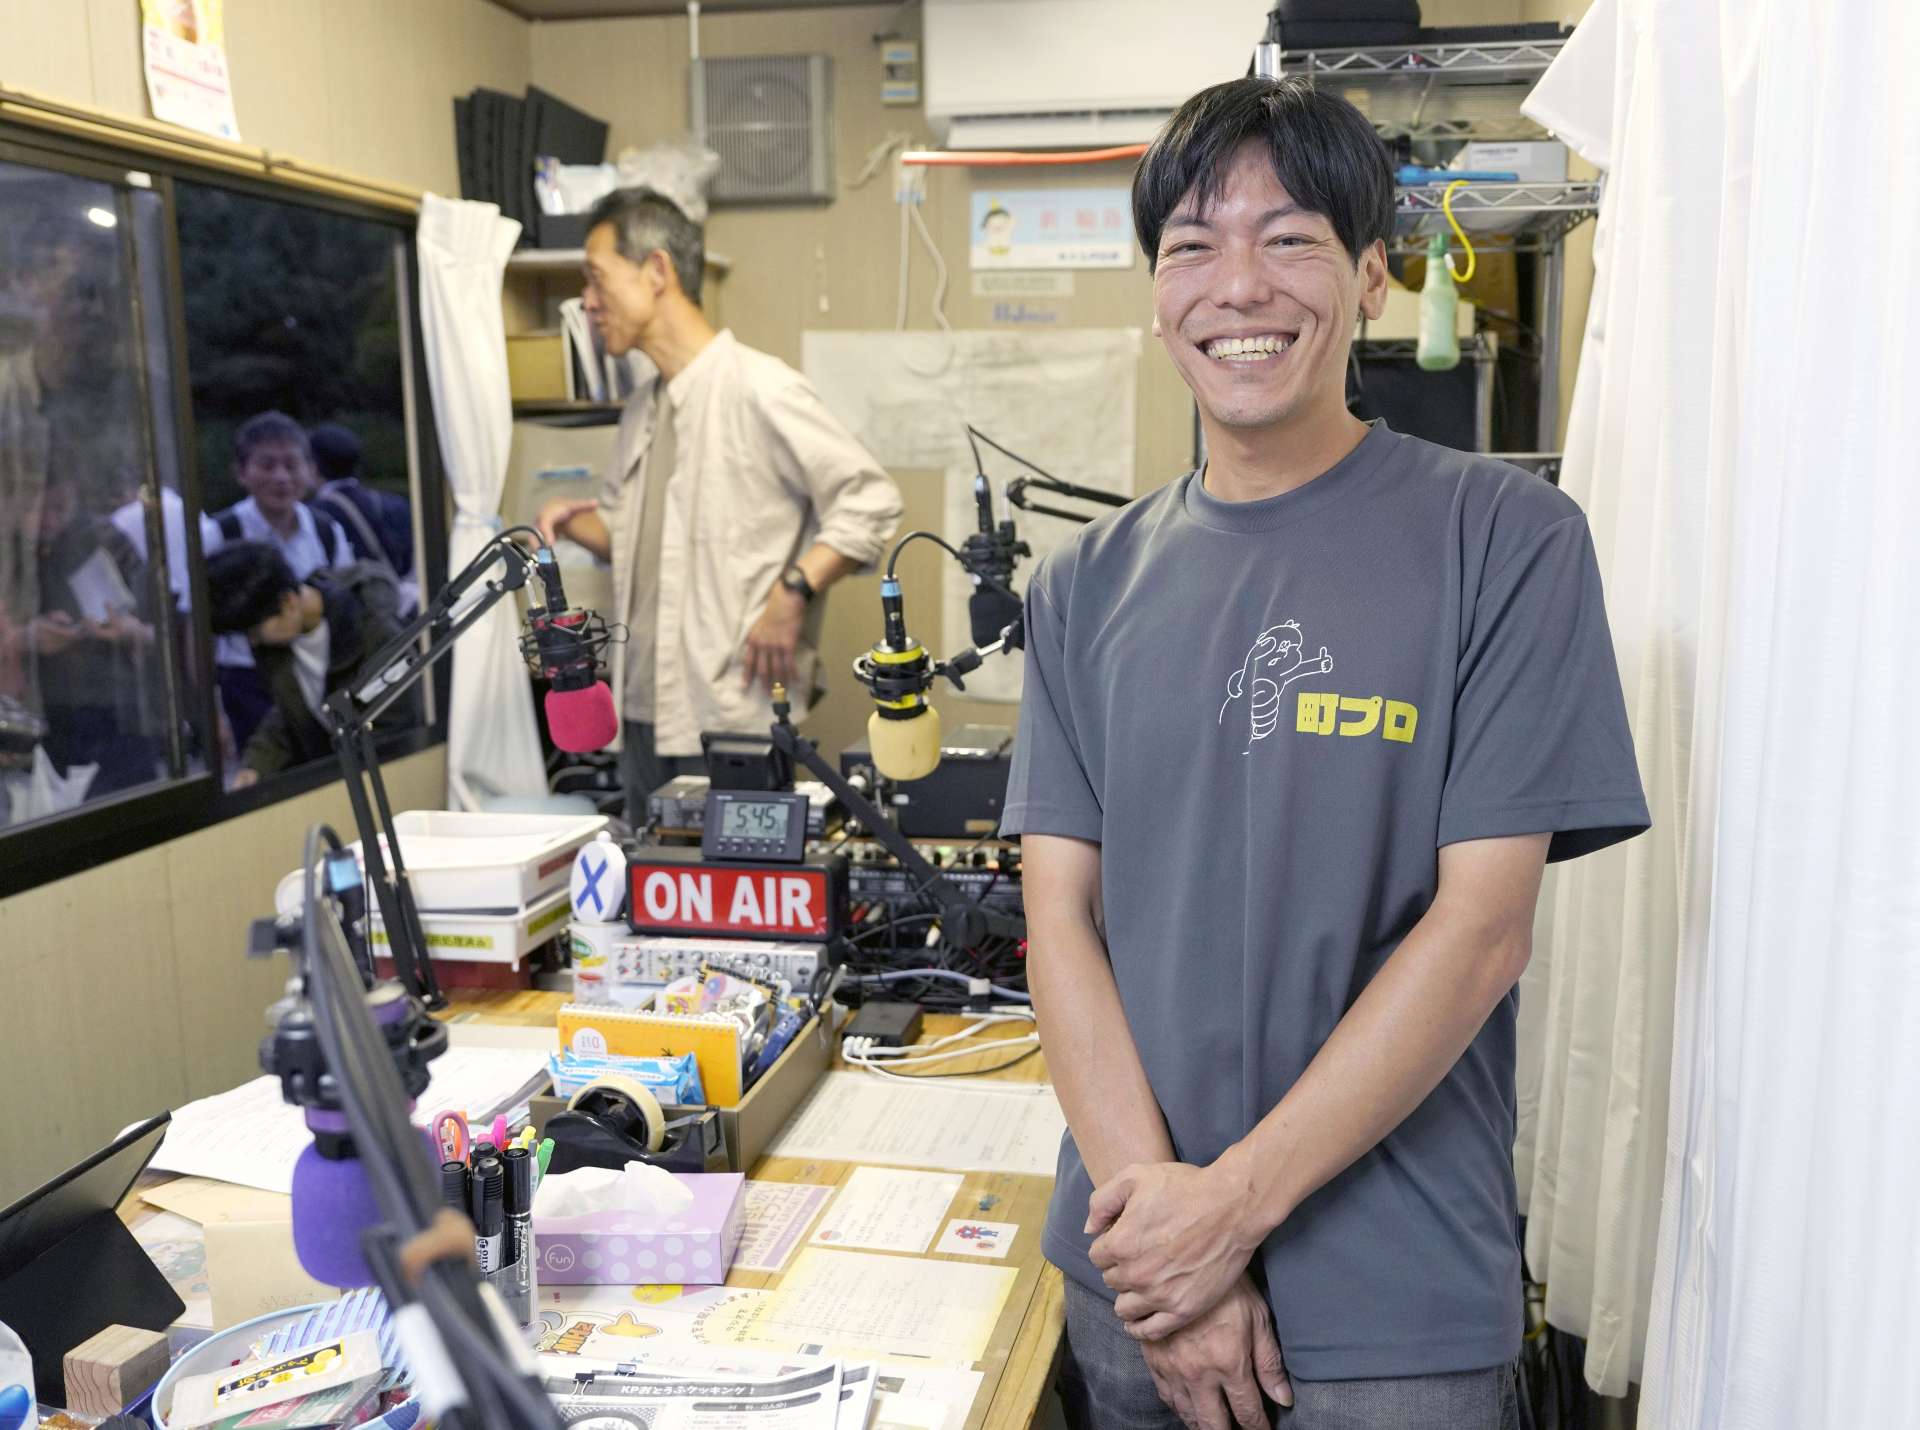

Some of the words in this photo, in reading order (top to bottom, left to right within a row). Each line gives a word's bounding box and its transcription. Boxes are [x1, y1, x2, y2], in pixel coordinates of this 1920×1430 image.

[1296, 692, 1418, 744] 町プロ
[643, 871, 713, 923] ON
[728, 875, 815, 928] AIR
